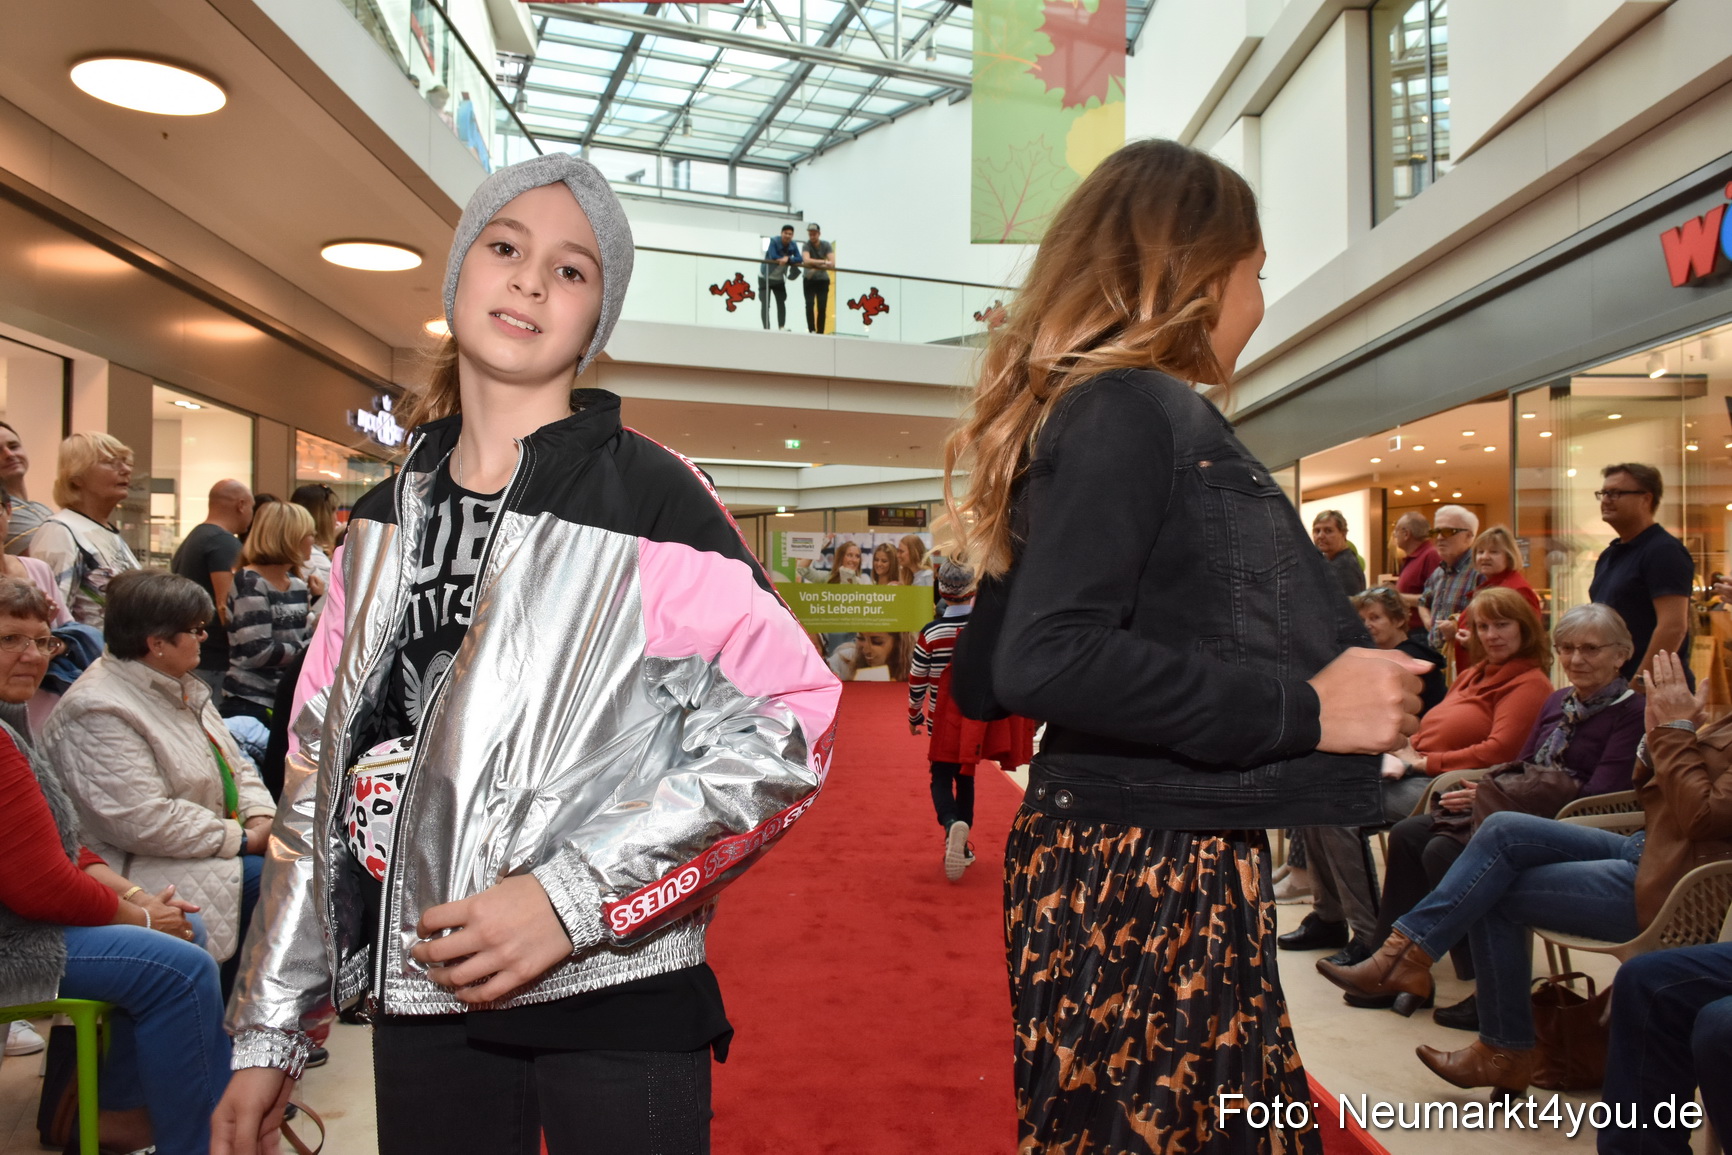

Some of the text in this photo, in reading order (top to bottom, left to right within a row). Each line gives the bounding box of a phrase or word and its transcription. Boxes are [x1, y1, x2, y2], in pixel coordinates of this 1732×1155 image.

[1660, 181, 1732, 288] W
[799, 591, 896, 604] Von Shoppingtour
[810, 604, 884, 616] bis Leben pur.
[704, 818, 782, 879] GUESS
[610, 867, 700, 932] GUESS
